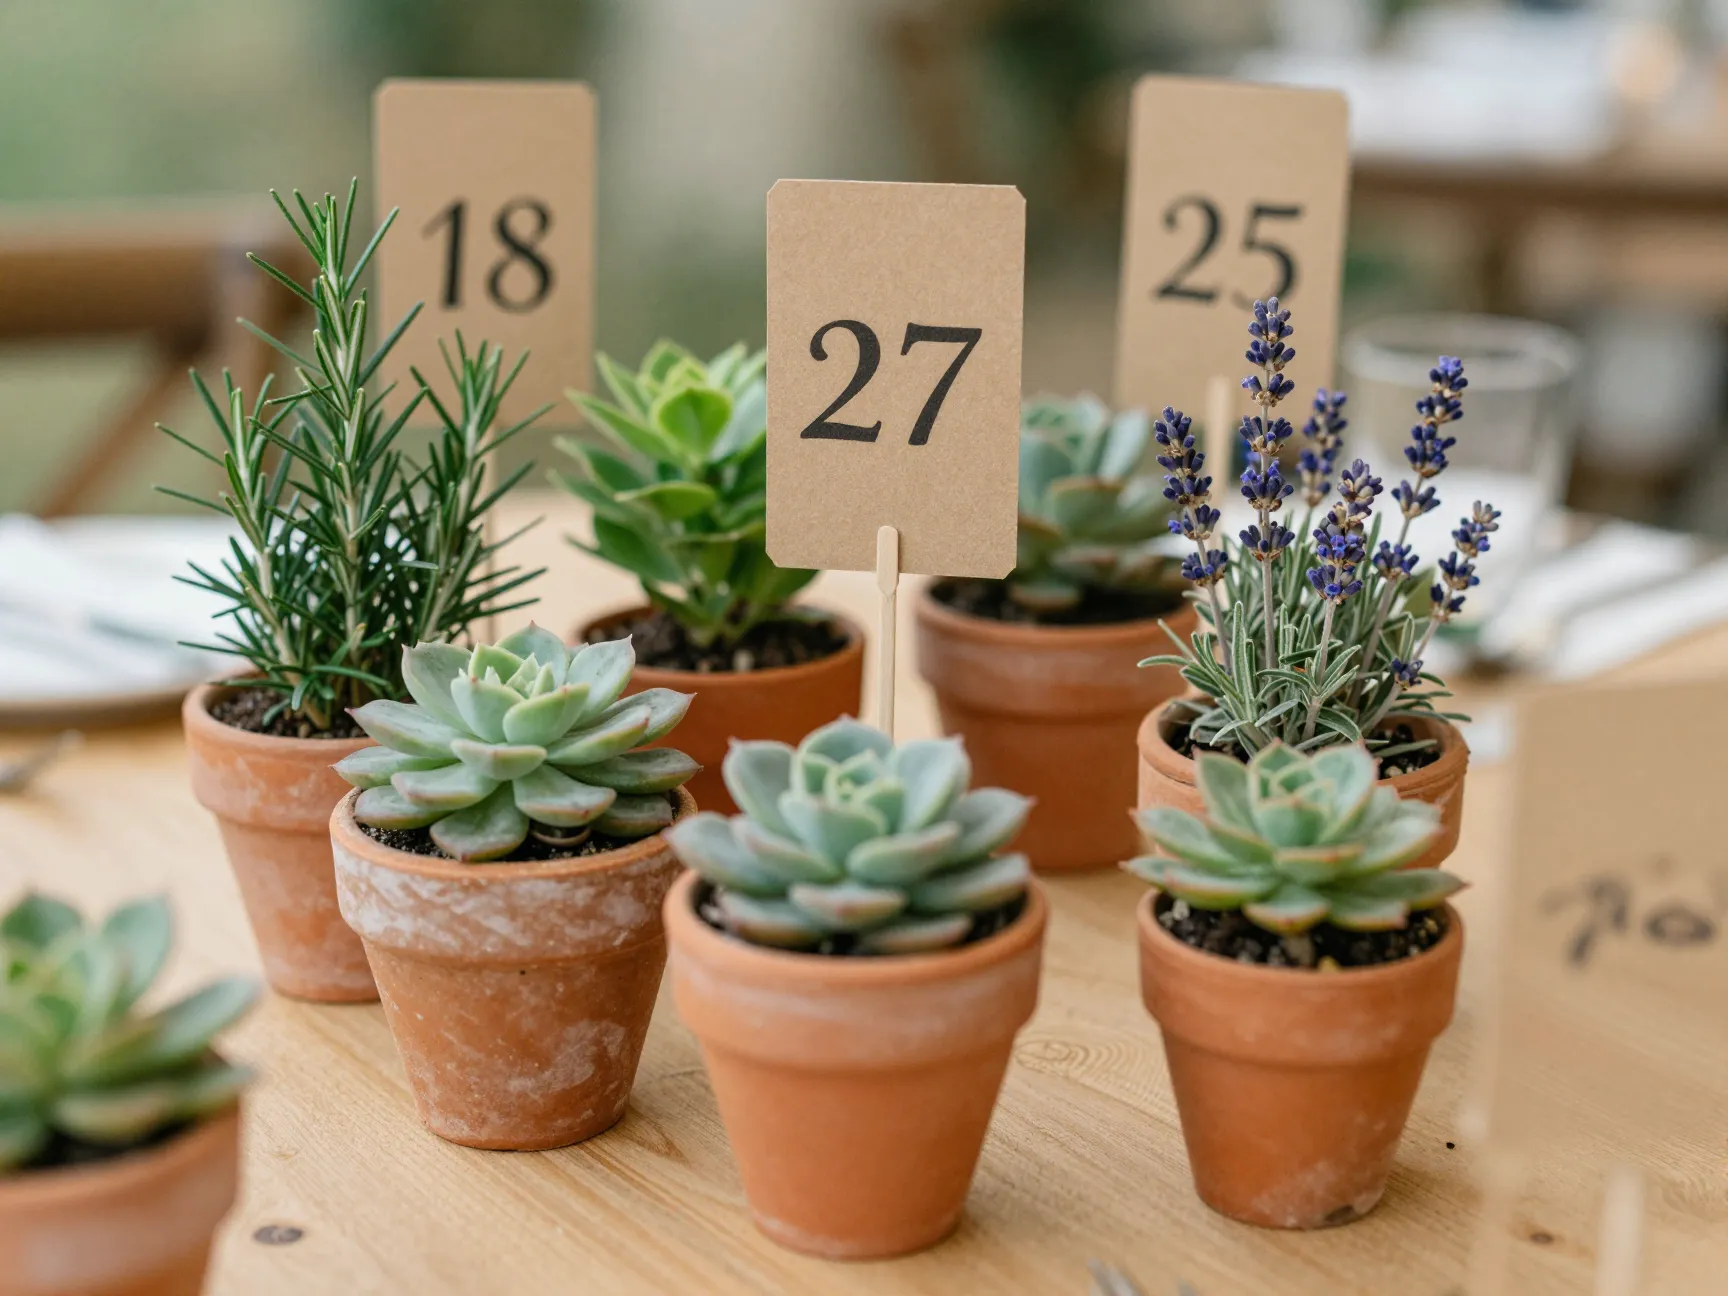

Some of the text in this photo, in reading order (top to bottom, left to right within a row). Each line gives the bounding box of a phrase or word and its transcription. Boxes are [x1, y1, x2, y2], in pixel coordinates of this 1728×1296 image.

[421, 198, 556, 313] 18
[1155, 195, 1304, 311] 25
[800, 319, 983, 447] 27
